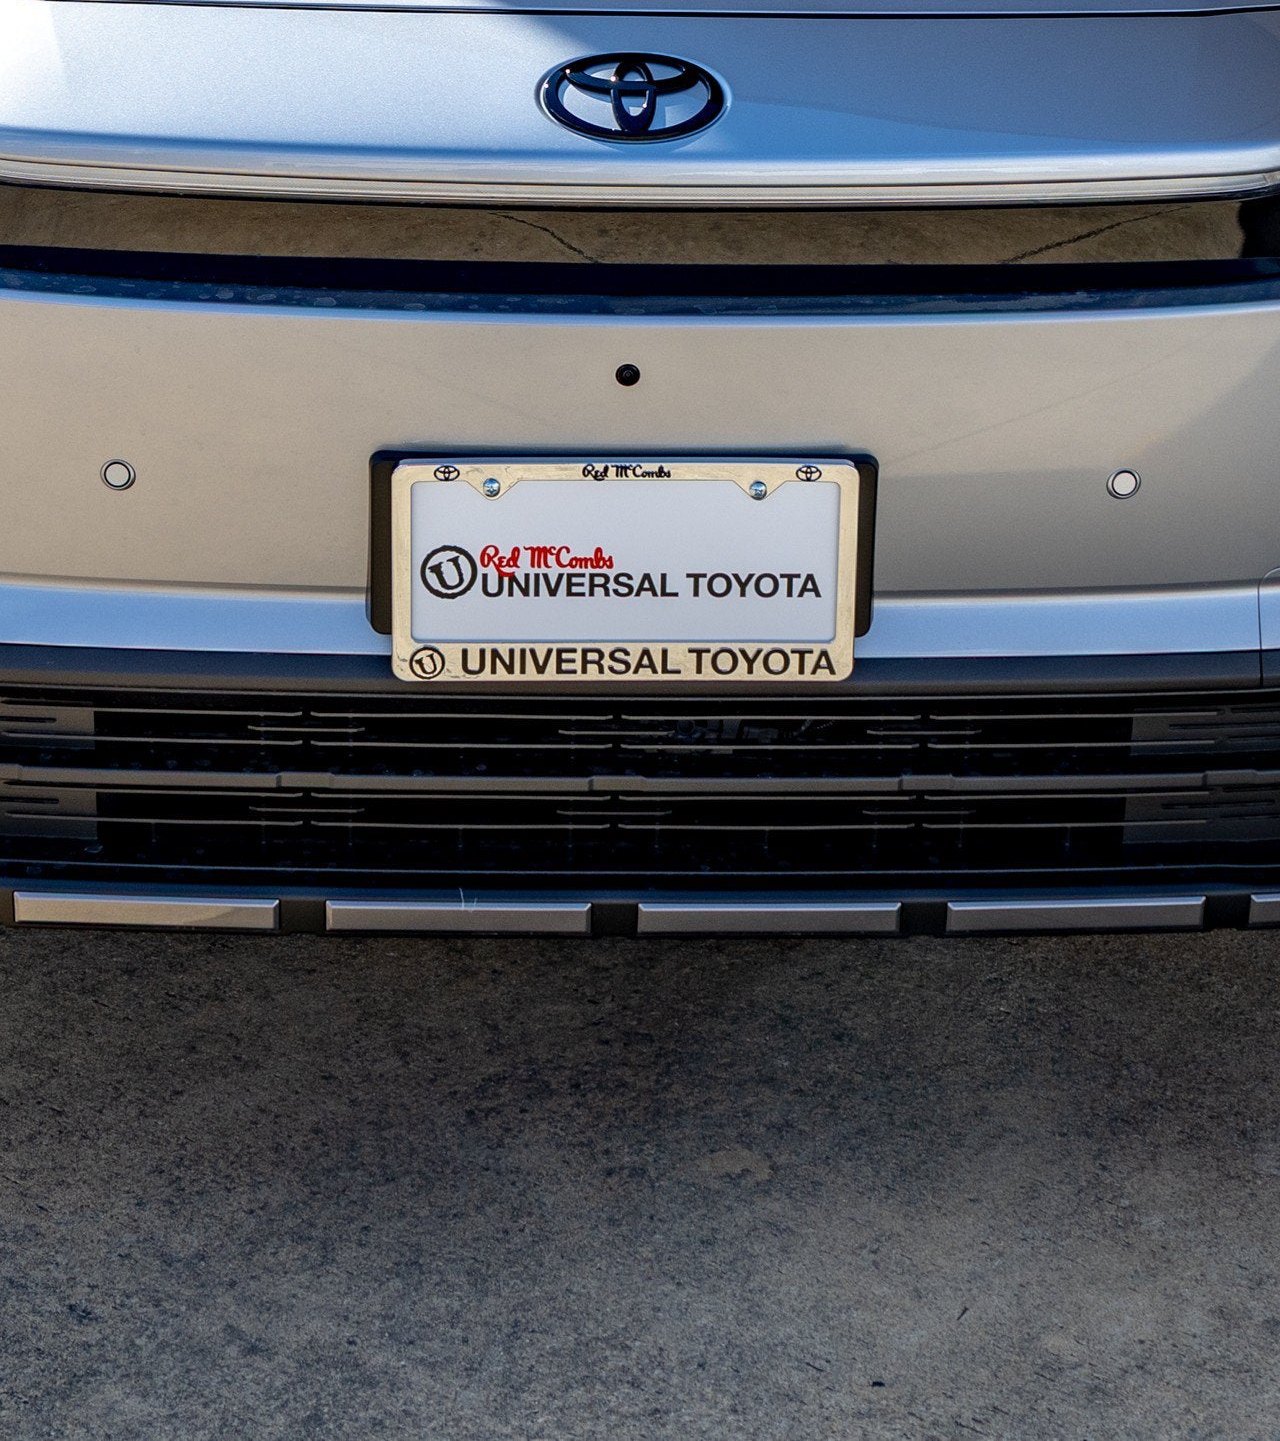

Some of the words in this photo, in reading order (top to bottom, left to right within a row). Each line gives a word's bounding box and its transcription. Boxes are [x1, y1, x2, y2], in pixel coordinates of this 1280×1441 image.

[582, 463, 609, 482] Red
[611, 463, 672, 479] McCombs
[479, 544, 521, 578] Red
[523, 545, 615, 570] McCombs
[481, 572, 679, 599] UNIVERSAL
[686, 572, 822, 599] TOYOTA
[461, 647, 682, 676] UNIVERSAL
[687, 647, 837, 676] TOYOTA
